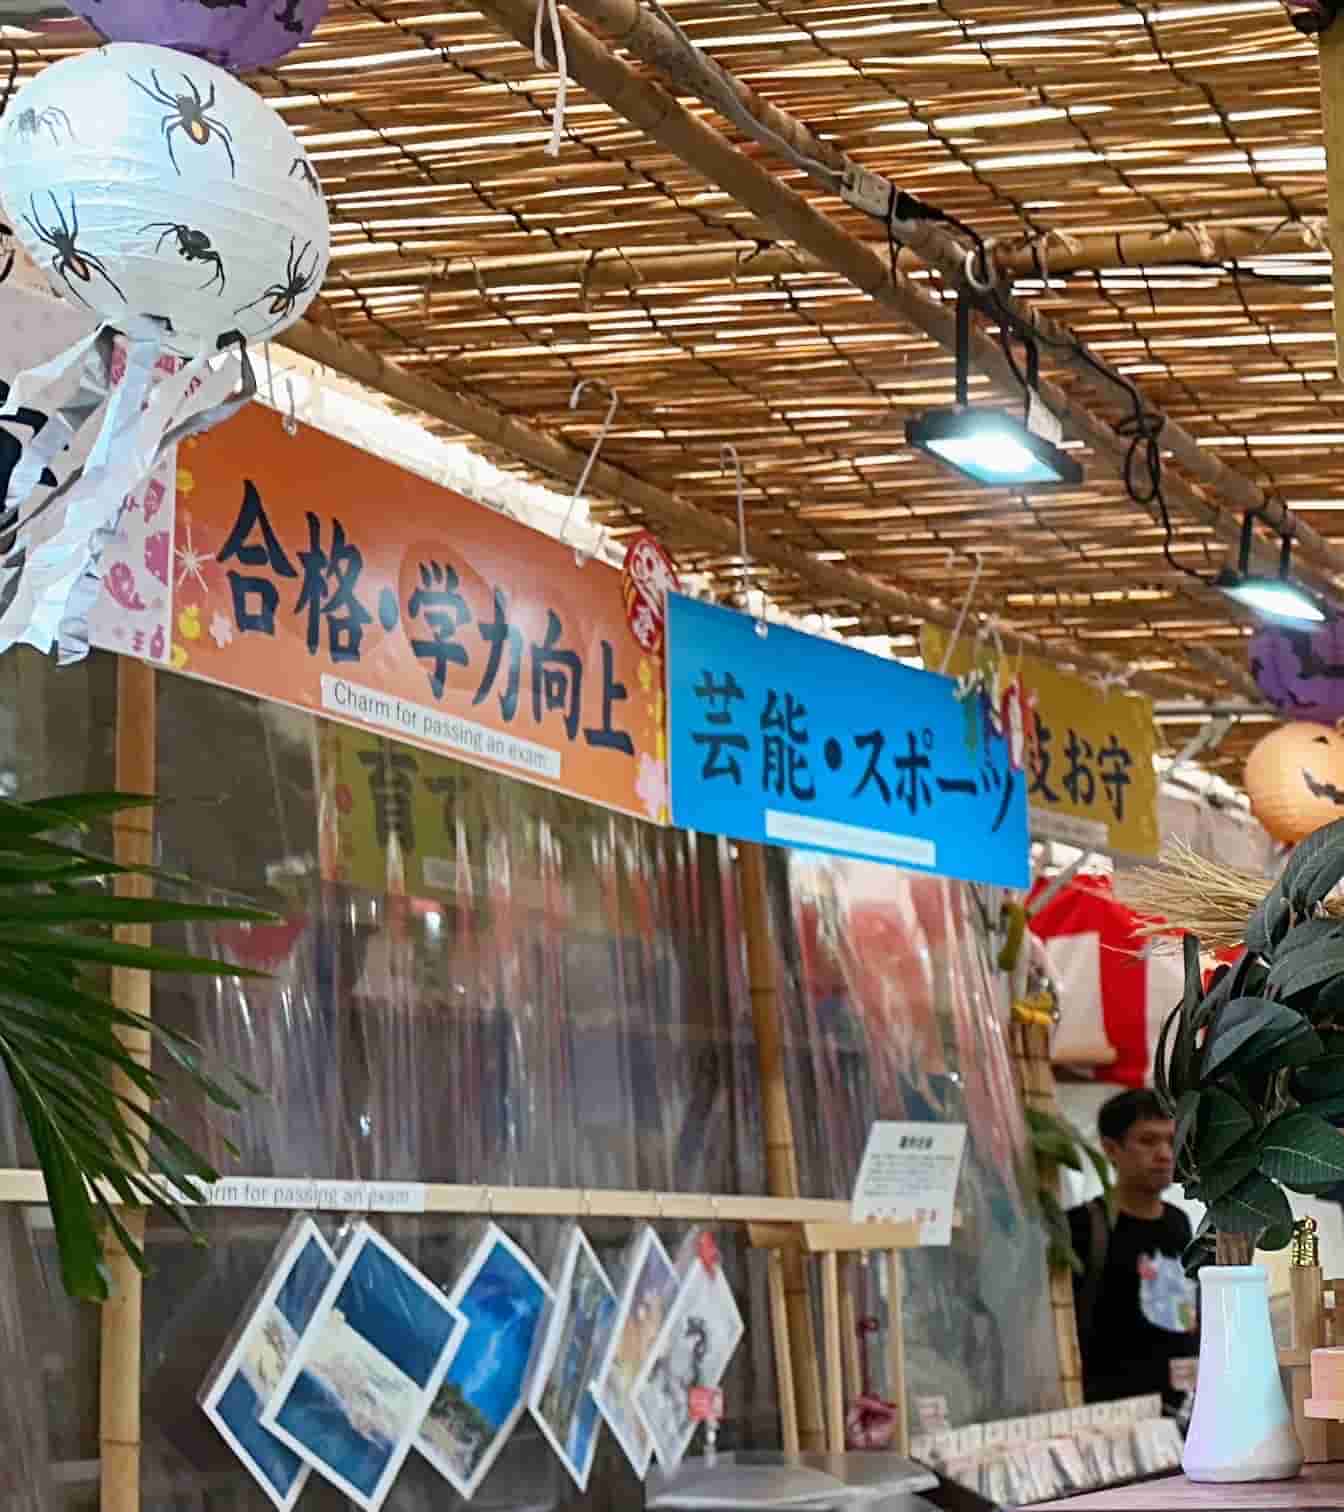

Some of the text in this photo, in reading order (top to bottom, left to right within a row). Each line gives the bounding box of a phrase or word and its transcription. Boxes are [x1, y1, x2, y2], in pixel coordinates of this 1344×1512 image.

[218, 479, 636, 757] 合格・学力向上
[333, 680, 391, 720] Charm
[396, 702, 419, 729] for
[422, 710, 484, 754] passing
[485, 735, 506, 755] an
